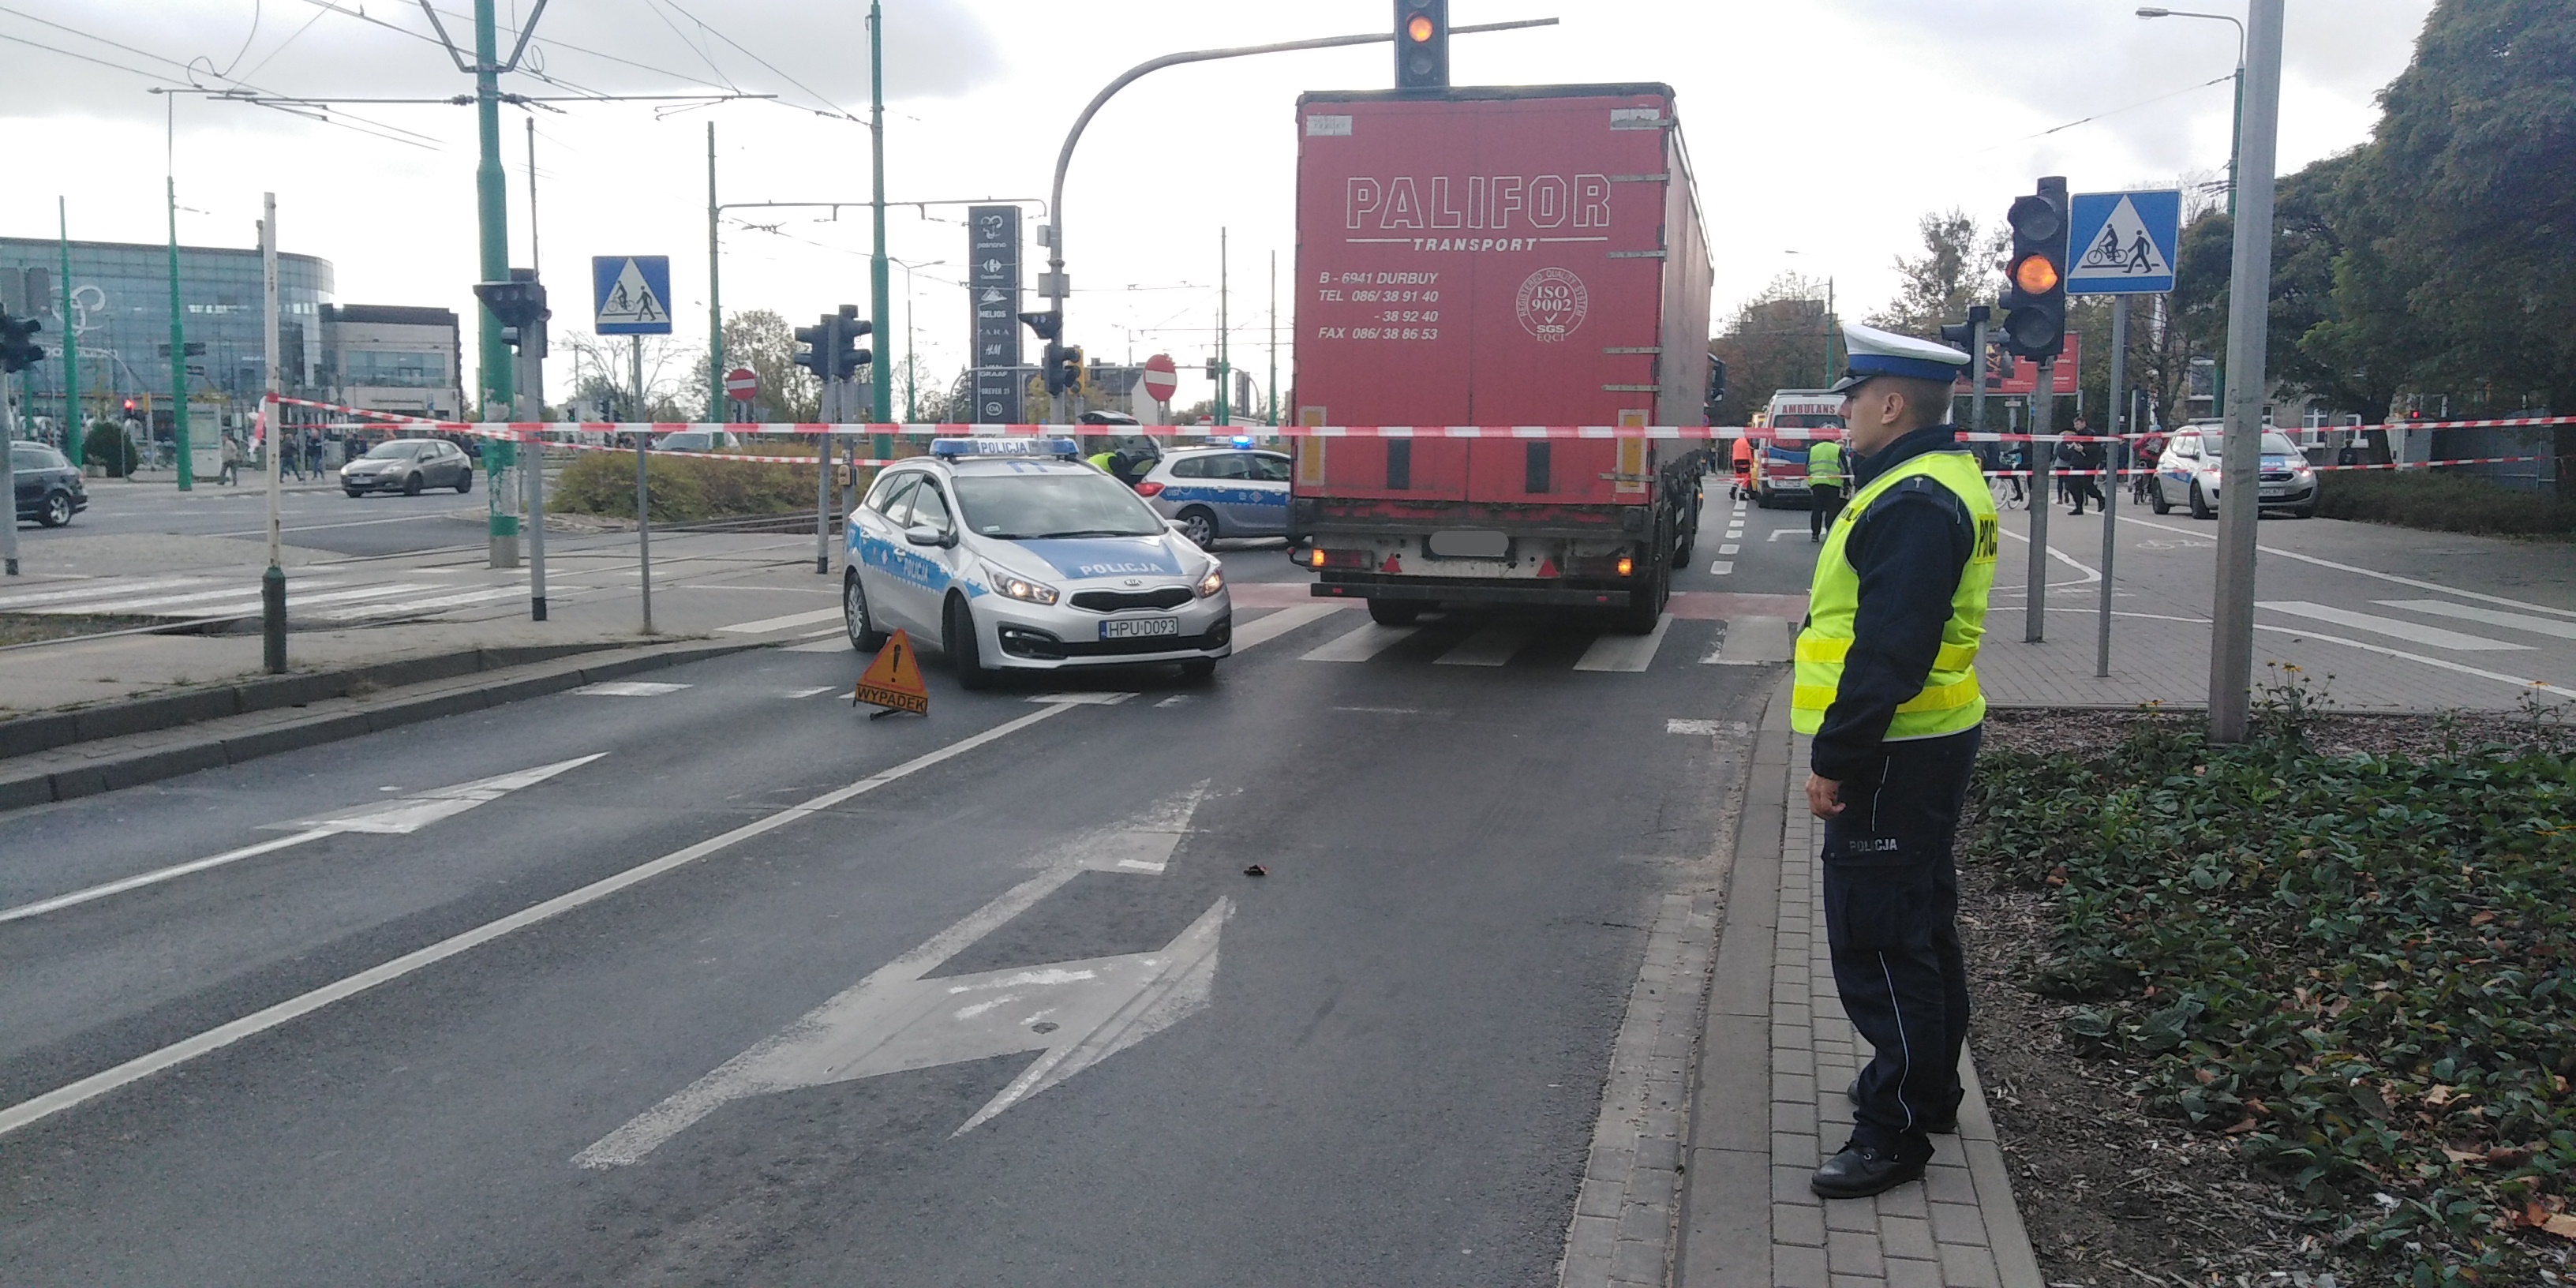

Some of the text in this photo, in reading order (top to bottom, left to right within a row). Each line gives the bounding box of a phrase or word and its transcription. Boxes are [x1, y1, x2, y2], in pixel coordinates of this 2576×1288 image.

[1346, 174, 1611, 229] PALIFOR
[1413, 238, 1537, 252] TRANSPORT
[1319, 271, 1330, 284] B
[1342, 272, 1372, 284] 6941
[1376, 272, 1438, 285] DURBUY
[1546, 269, 1576, 284] QUALITY
[1319, 290, 1439, 302] TEL 086/ 38 91 40
[1518, 273, 1543, 317] REGISTERED
[1537, 286, 1568, 298] ISO
[1532, 298, 1571, 312] 9002
[1574, 285, 1586, 317] SYSTEM
[1383, 310, 1399, 322] 38
[1402, 310, 1419, 322] 92
[1421, 310, 1438, 322] 40
[1318, 327, 1438, 339] FAX 086/ 38 86 53
[1537, 324, 1565, 333] SGS
[1537, 333, 1564, 343] EQCI
[1781, 404, 1836, 414] AMBULANS
[980, 442, 1028, 454] POLICJA
[904, 558, 929, 582] POLICJA
[1079, 563, 1165, 575] POLICJA
[1109, 622, 1140, 637] HPU
[857, 687, 925, 711] WYPADEK
[1848, 838, 1898, 852] POLCJA
